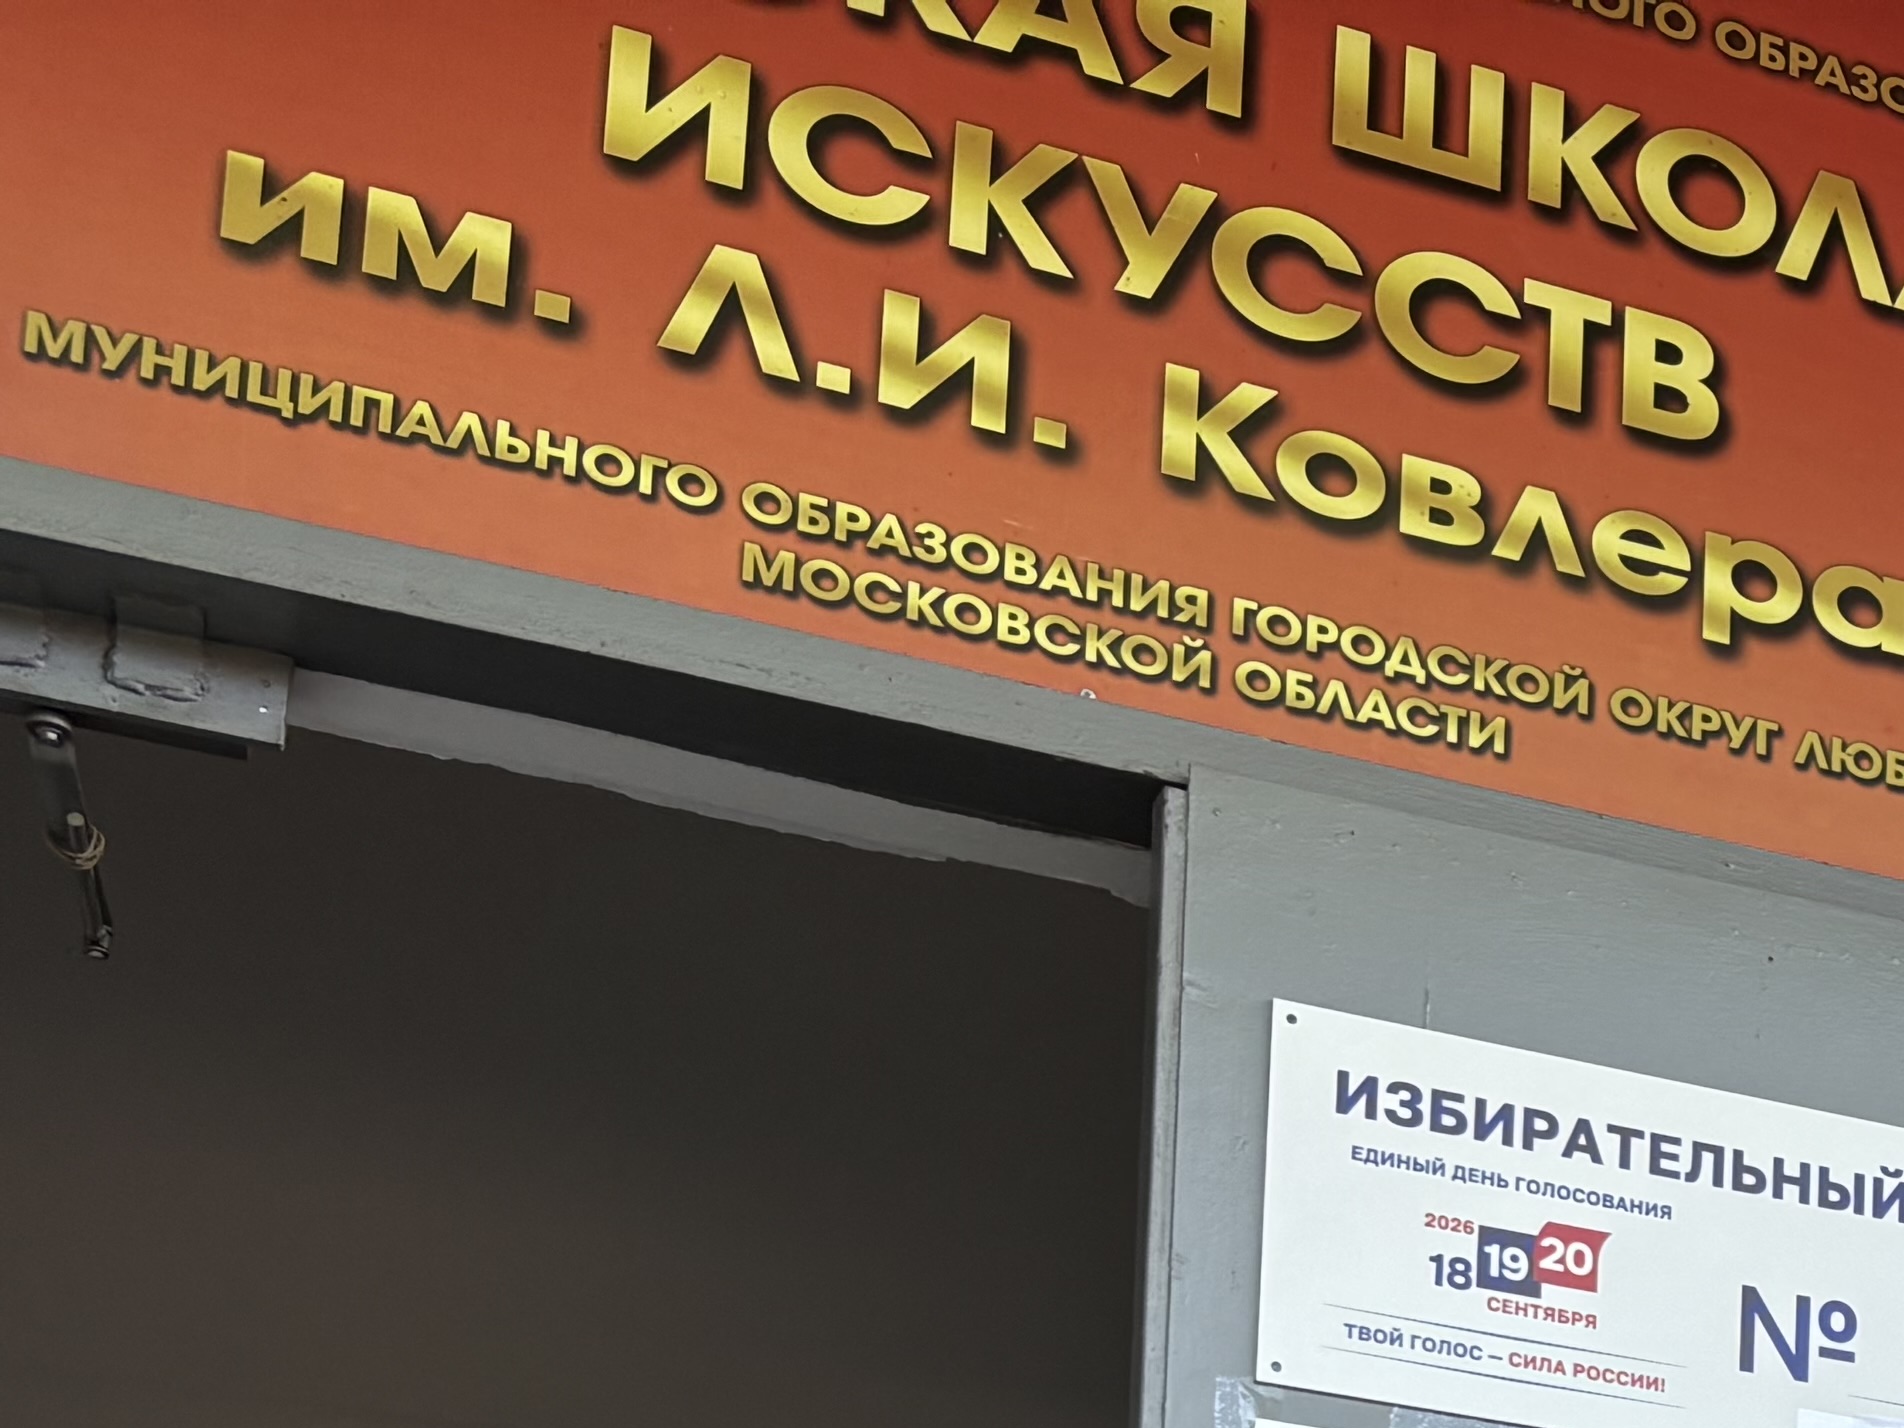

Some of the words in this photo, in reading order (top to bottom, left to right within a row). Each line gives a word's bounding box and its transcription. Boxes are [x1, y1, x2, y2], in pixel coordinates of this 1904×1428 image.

[603, 25, 1720, 440] ИСКУССТВ
[657, 243, 1067, 449] Л.И.
[22, 310, 718, 507] МУНИЦИПАЛЬНОГО
[741, 481, 1208, 628] ОБРАЗОВАНИЯ
[1231, 597, 1590, 716] ГОРОДСКОЙ
[1610, 688, 1780, 756] ОКРУГ
[741, 541, 1212, 689] МОСКОВСКОЙ
[1234, 660, 1506, 755] ОБЛАСТИ
[1351, 1144, 1446, 1178] ЕДИНЫЙ
[1451, 1163, 1510, 1190] ДЕНЬ
[1514, 1176, 1673, 1221] ГОЛОСОВАНИЯ
[1423, 1212, 1476, 1236] 2026
[1429, 1253, 1473, 1290] 18
[1484, 1243, 1529, 1281] 19
[1539, 1236, 1594, 1276] 20
[1487, 1296, 1598, 1330] СЕНТЯБРЯ
[1739, 1284, 1859, 1384] №
[1343, 1322, 1404, 1349] ТВОЙ
[1409, 1333, 1484, 1361] ГОЛОС
[1508, 1351, 1567, 1377] СИЛА
[1572, 1361, 1667, 1393] РОССИИ!
